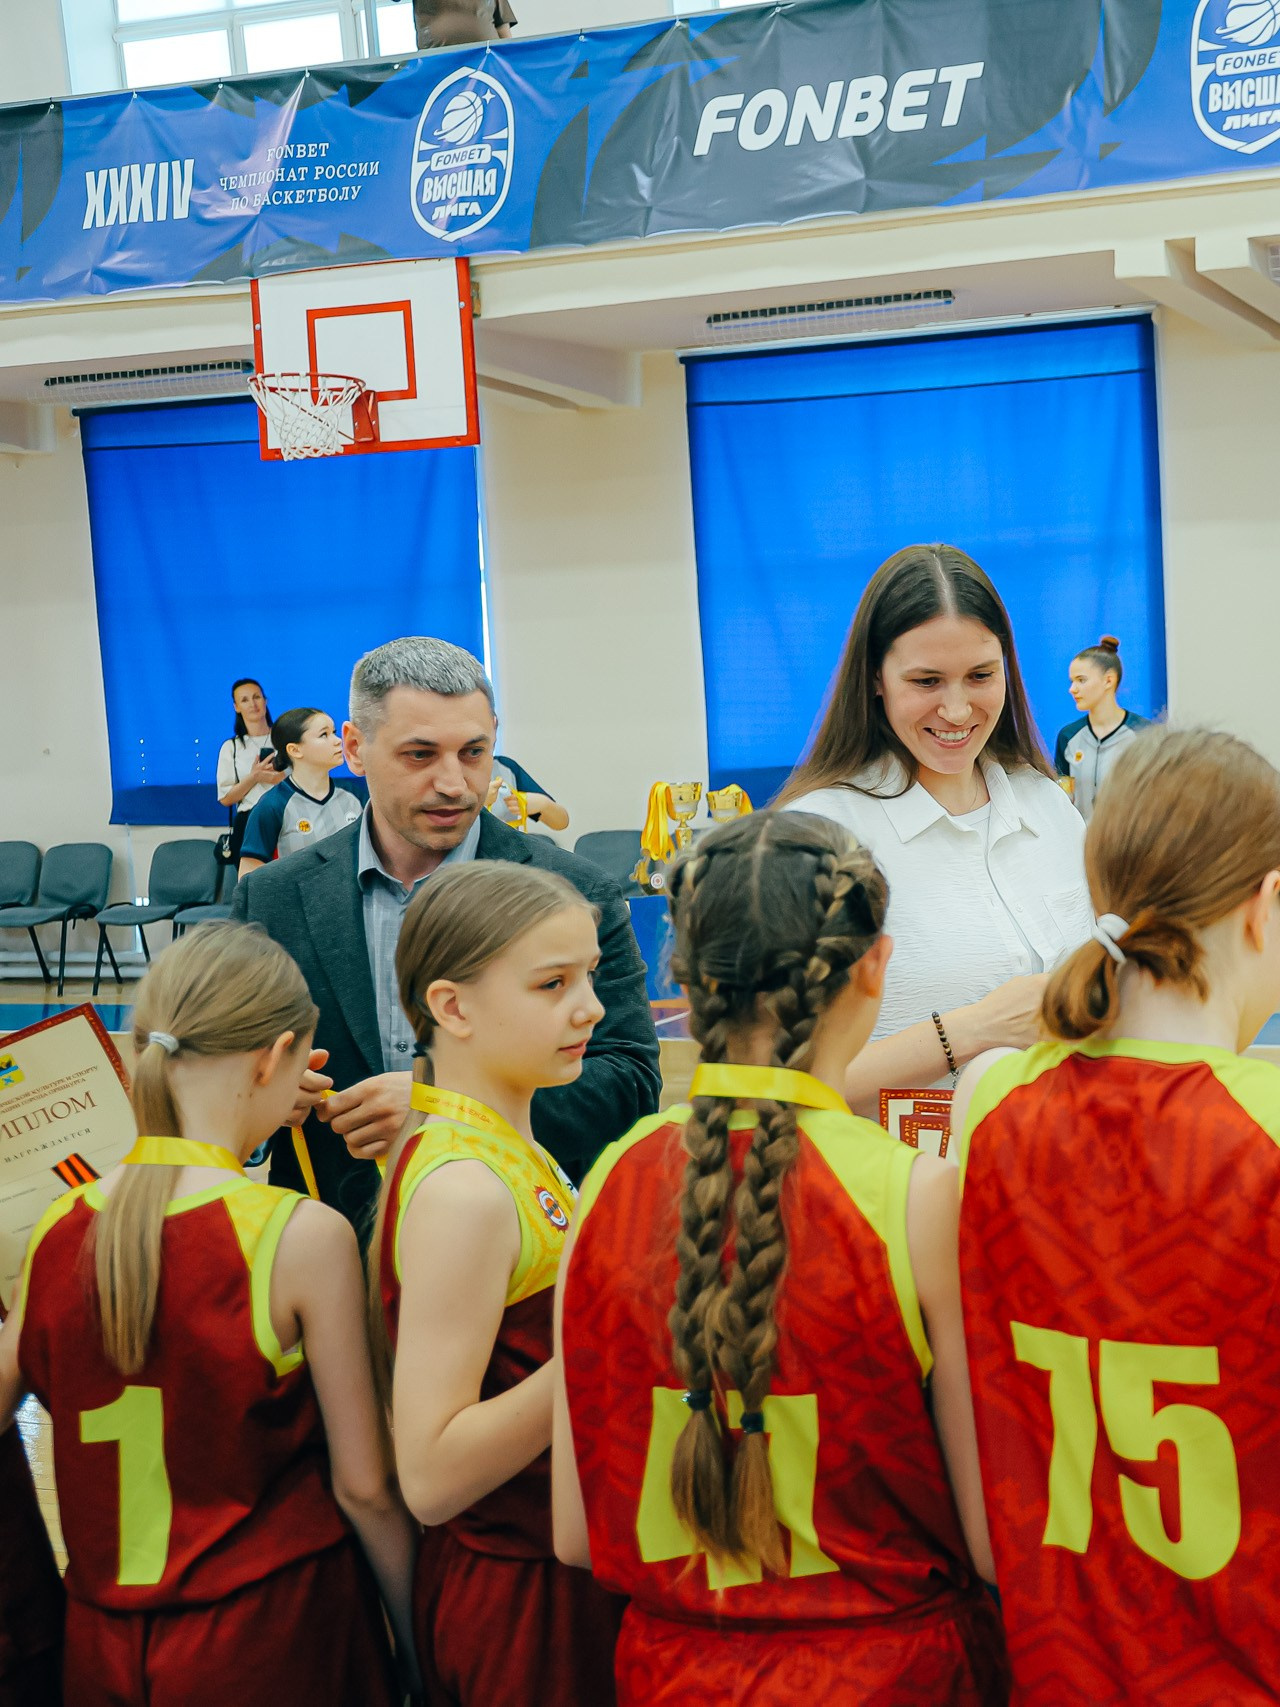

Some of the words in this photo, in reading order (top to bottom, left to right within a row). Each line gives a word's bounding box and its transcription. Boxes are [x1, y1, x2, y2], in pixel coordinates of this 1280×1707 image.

[693, 61, 984, 157] FONBET
[266, 142, 330, 162] FONBET
[435, 148, 486, 167] FONBET
[219, 166, 309, 191] ЧЕМПИОНАТ
[314, 161, 380, 181] РОССИИ
[422, 168, 497, 204] ВЫСШАЯ
[82, 158, 195, 230] XXXIV
[230, 196, 249, 211] ПО
[252, 185, 362, 207] БАСКЕТБОЛУ
[432, 201, 482, 221] ЛИГА
[1010, 1320, 1241, 1580] 15
[79, 1385, 173, 1586] 1
